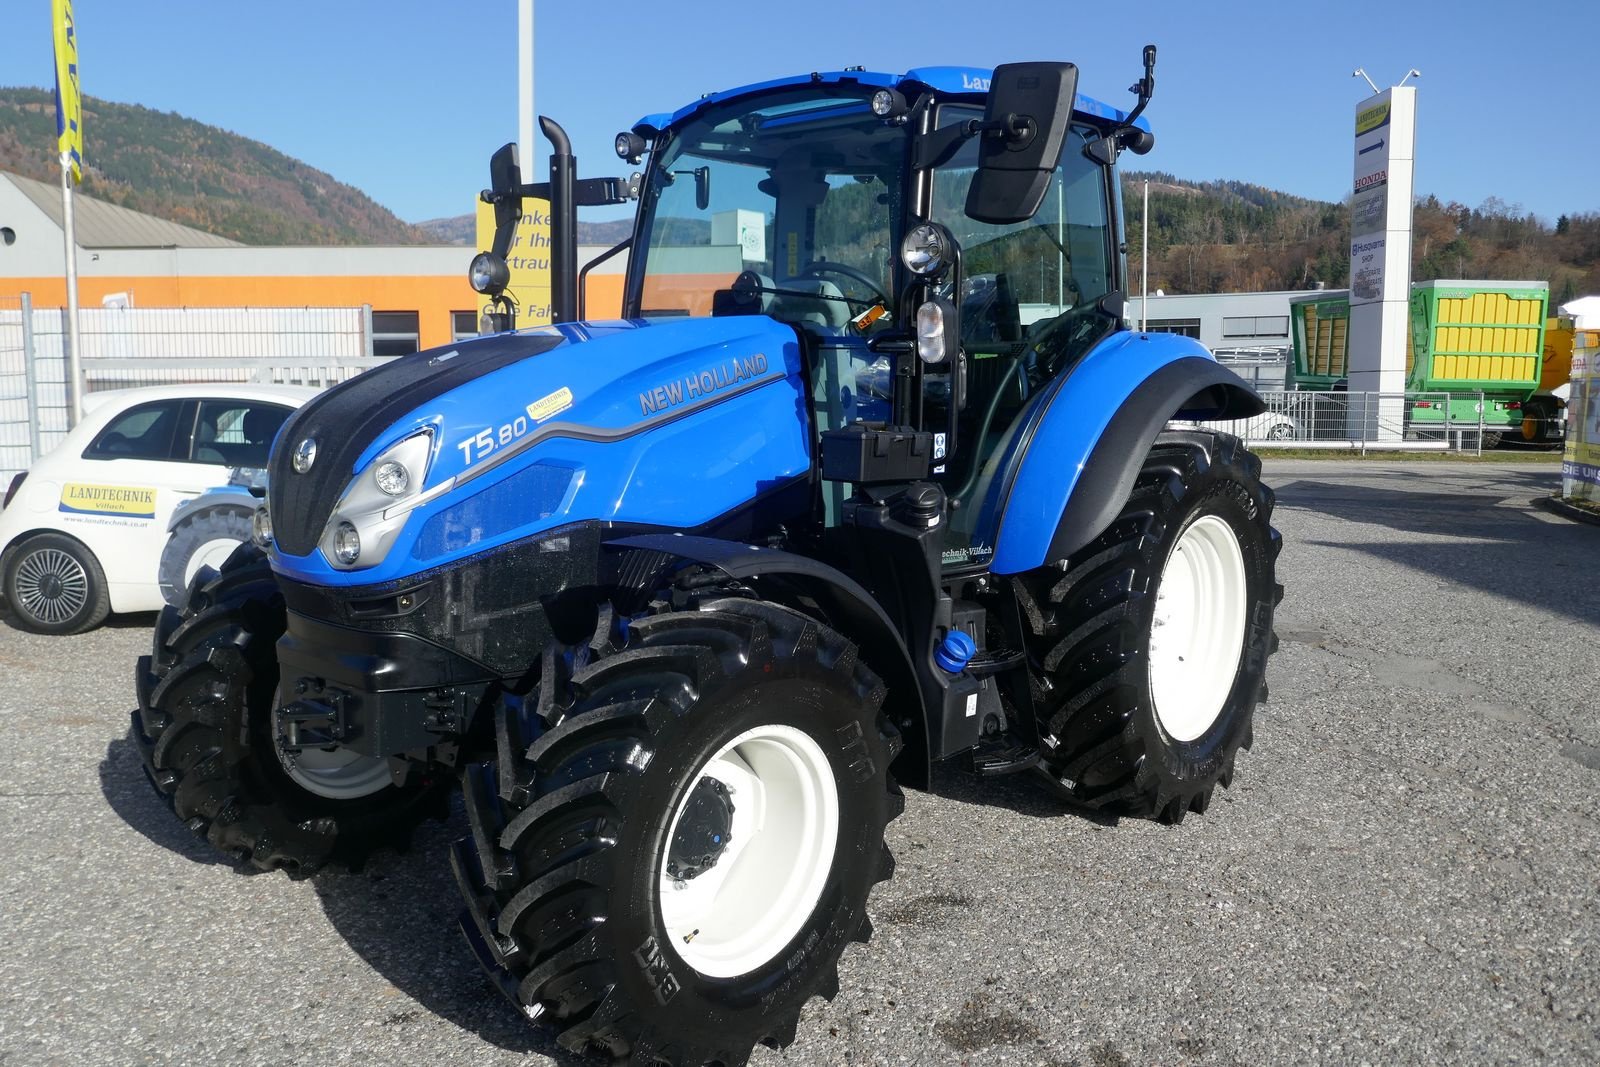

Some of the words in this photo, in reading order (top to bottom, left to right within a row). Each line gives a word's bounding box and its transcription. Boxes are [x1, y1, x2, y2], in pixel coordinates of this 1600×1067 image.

[963, 74, 991, 90] Lan
[1354, 170, 1387, 189] HONDA
[521, 210, 551, 225] nke
[1357, 240, 1385, 253] Husqvarna
[1361, 254, 1374, 263] SHOP
[639, 380, 684, 417] NEW
[685, 353, 769, 400] HOLLAND
[457, 416, 527, 466] T5.80
[70, 486, 152, 503] LANDTECHNIK
[95, 502, 126, 511] Villach
[942, 546, 992, 557] echnik-Villach
